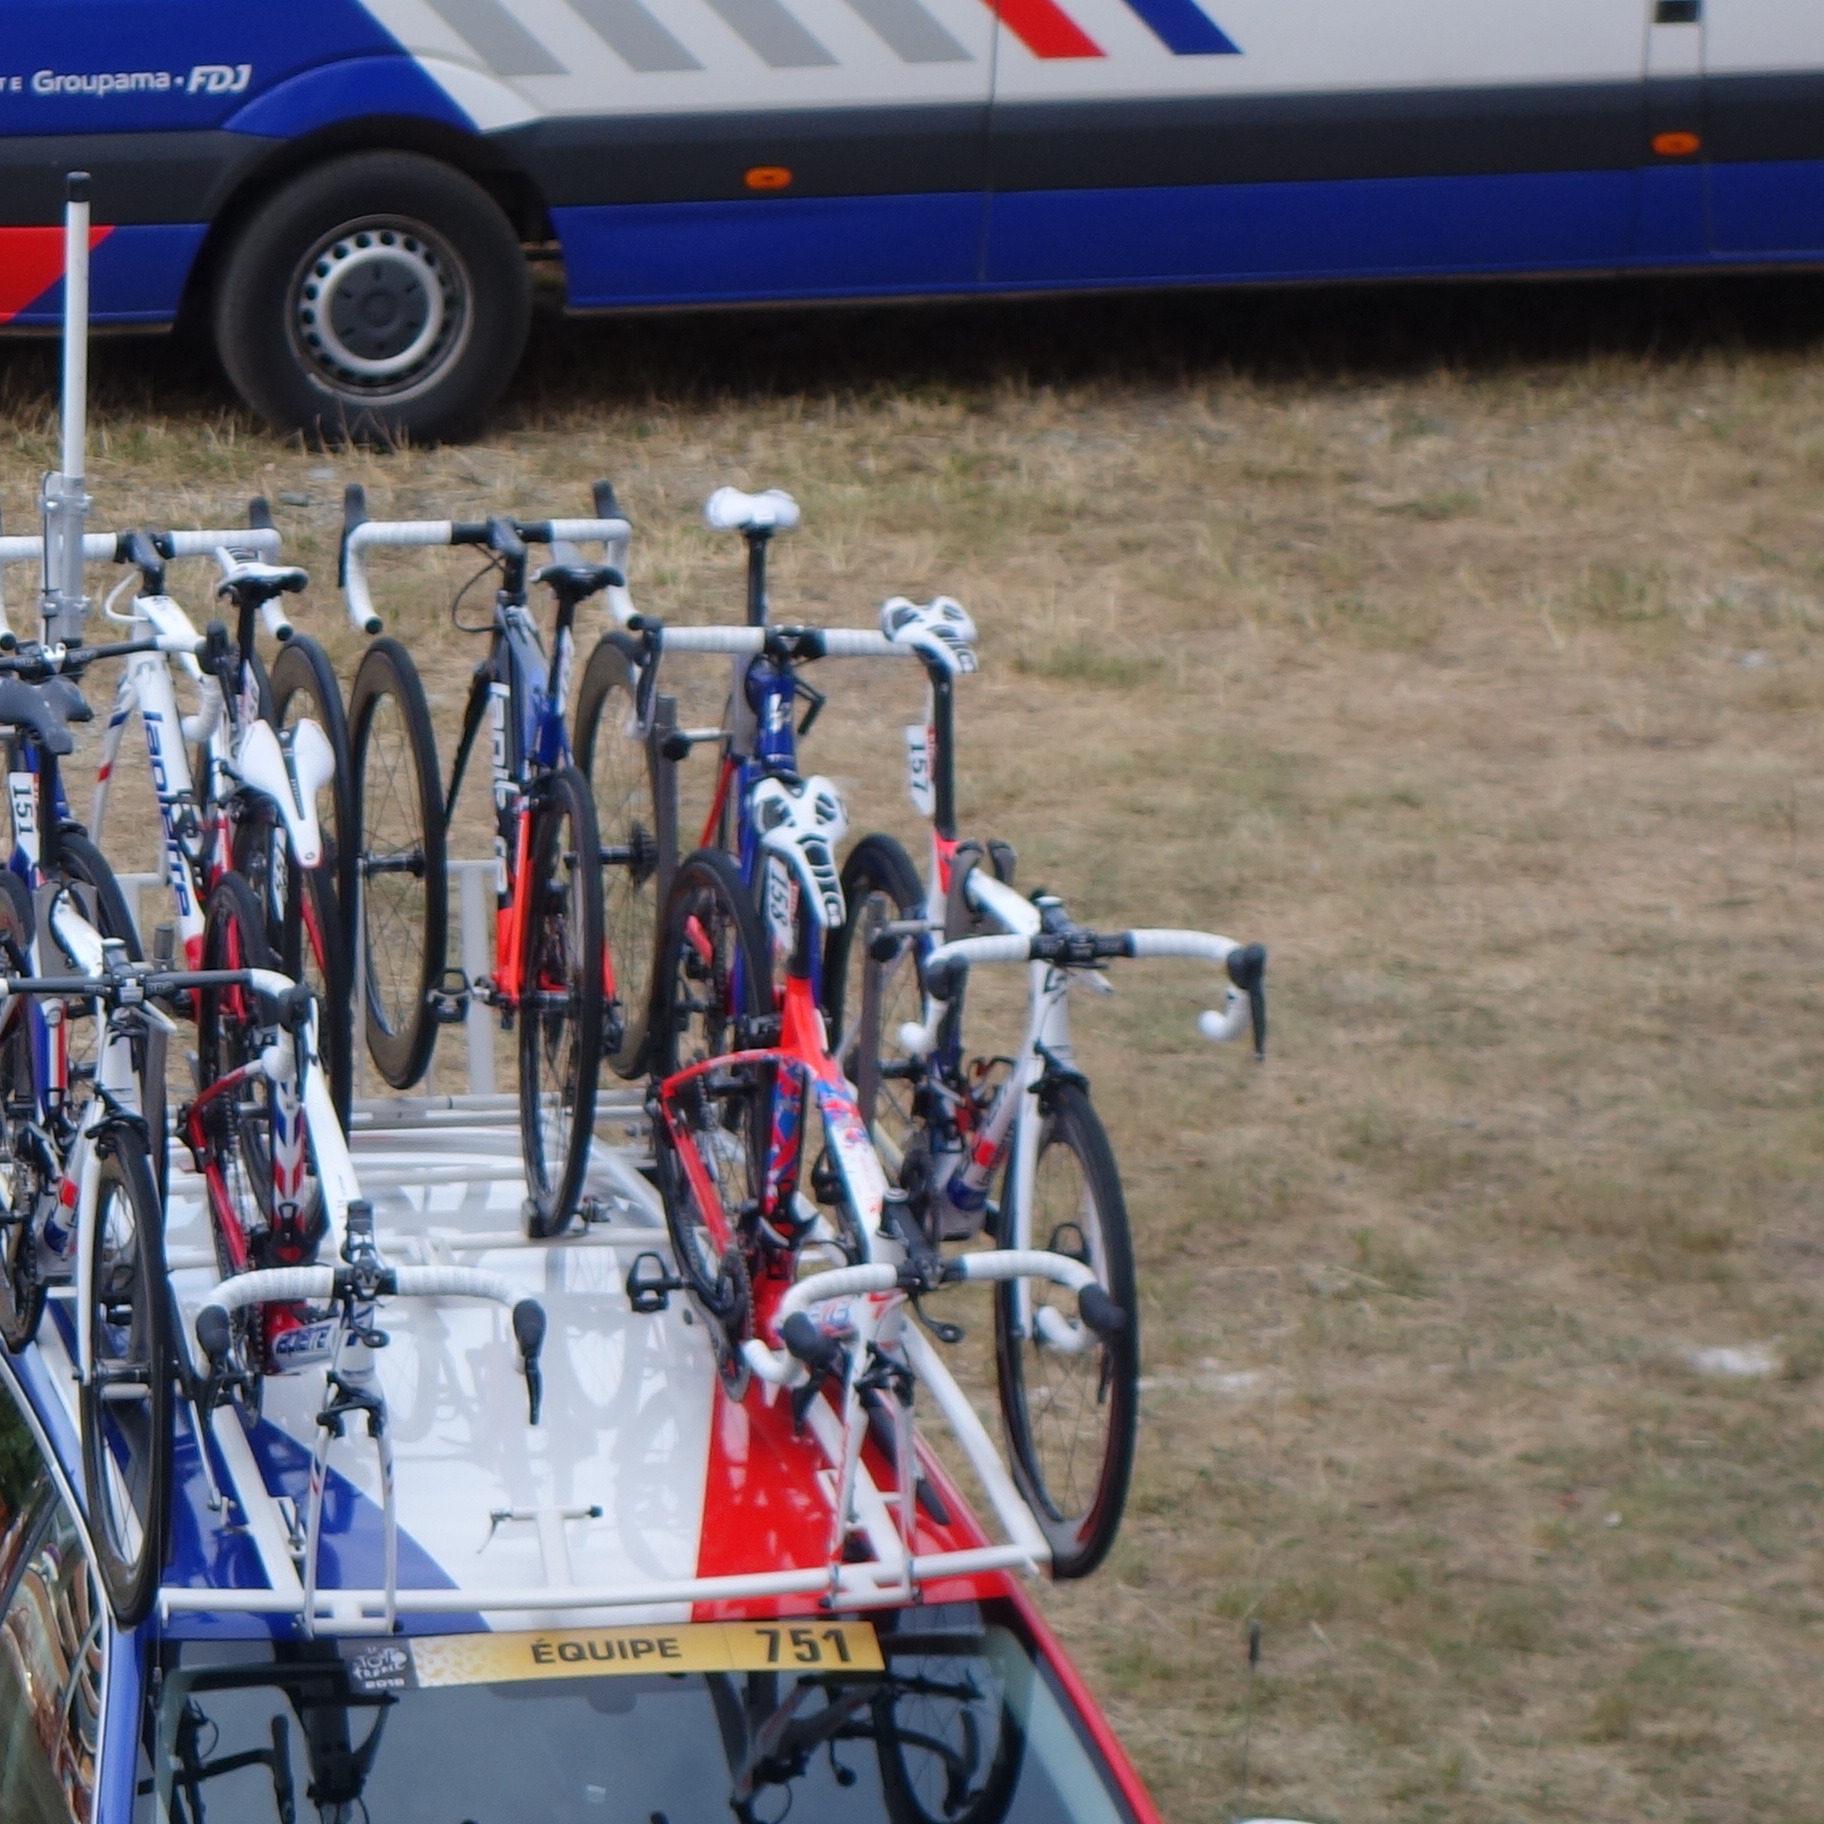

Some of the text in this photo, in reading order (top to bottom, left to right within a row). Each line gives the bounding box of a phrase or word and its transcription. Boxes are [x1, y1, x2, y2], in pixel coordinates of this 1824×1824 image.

[32, 69, 171, 97] Groupama
[184, 63, 254, 94] FDJ
[909, 742, 929, 794] 157
[11, 783, 34, 836] 151
[530, 1627, 853, 1665] ÉQUIPE 751
